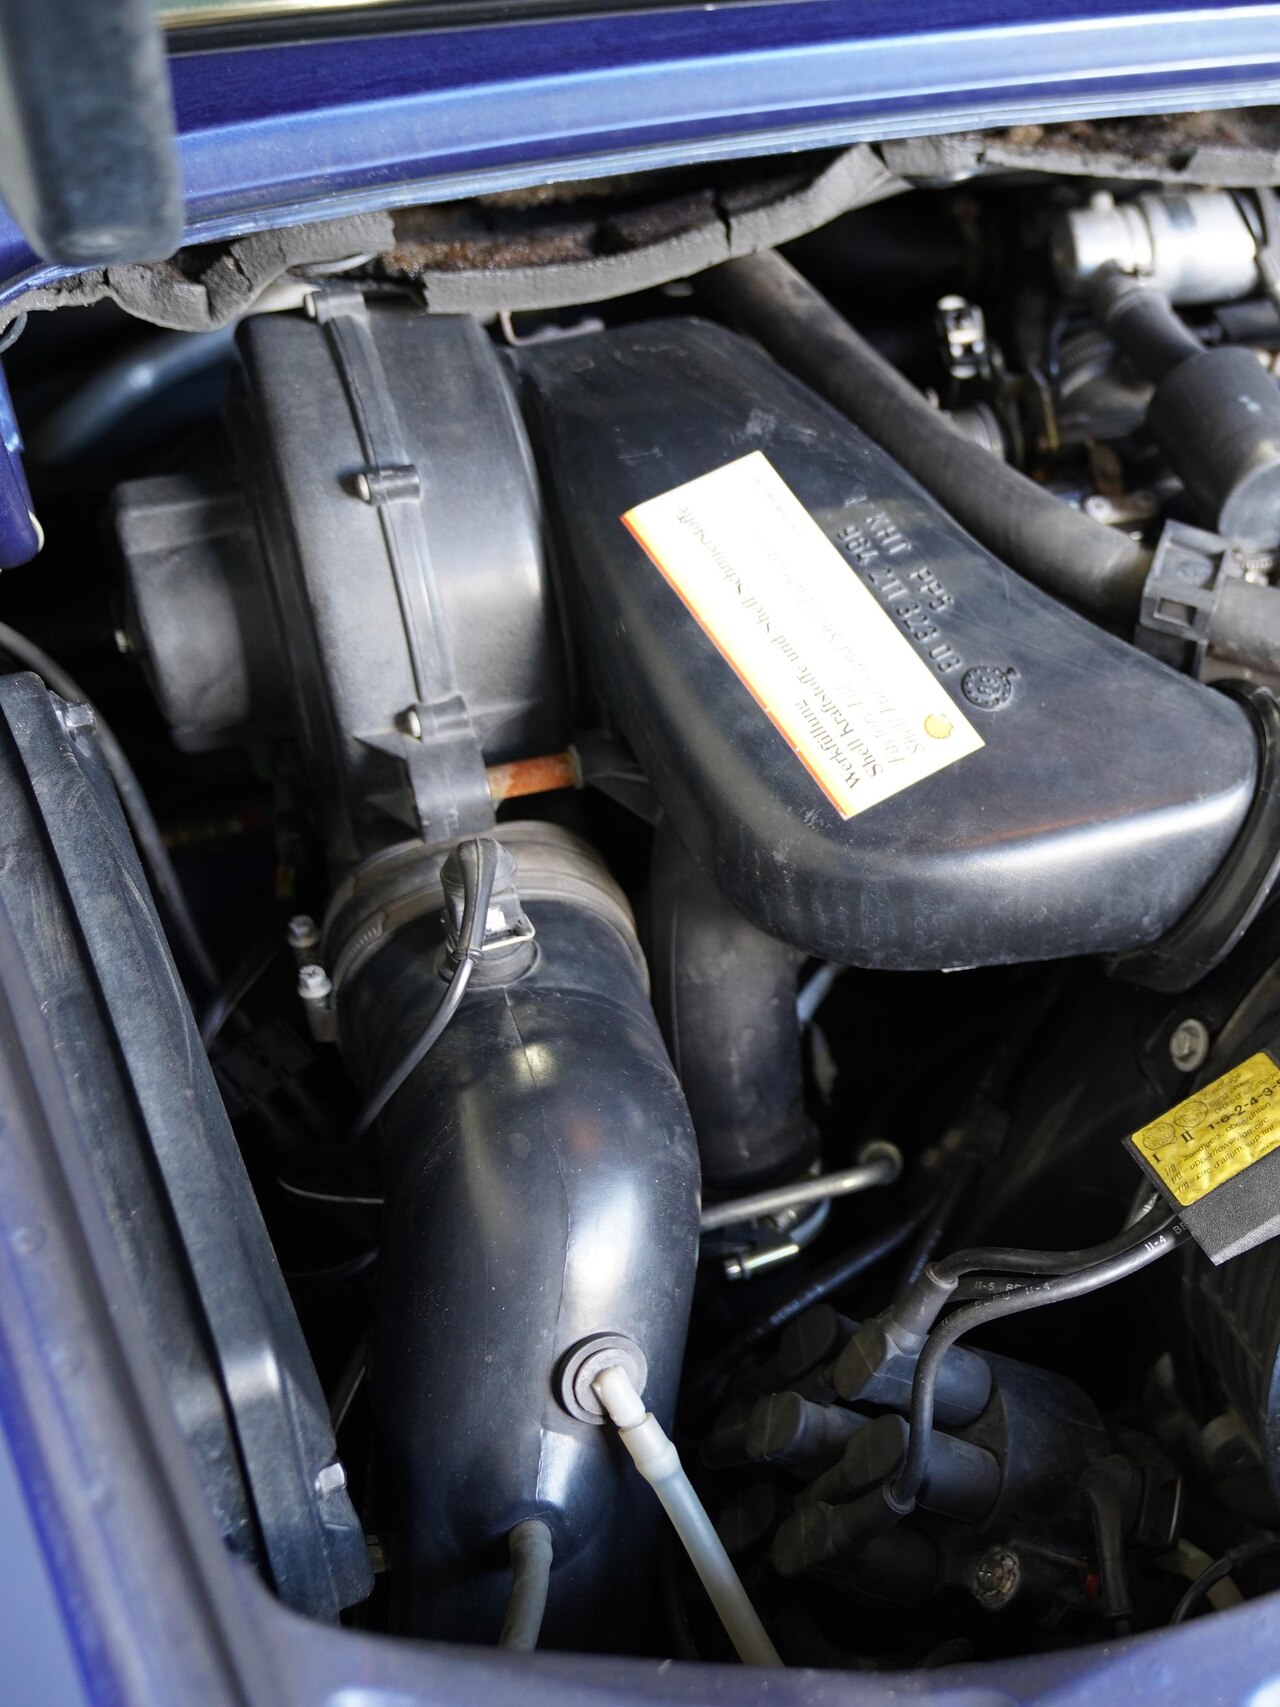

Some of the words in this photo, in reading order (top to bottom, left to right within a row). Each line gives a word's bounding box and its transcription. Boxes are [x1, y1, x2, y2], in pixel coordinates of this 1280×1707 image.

[671, 504, 749, 596] Schmierstoffe
[741, 596, 777, 634] Shell
[835, 522, 881, 568] 964
[867, 562, 909, 604] 211
[894, 596, 942, 648] 323
[927, 639, 964, 678] 03
[769, 634, 799, 663] und
[791, 664, 855, 737] Kraftstoffe
[789, 698, 866, 788] Werkfüllung
[846, 737, 885, 778] Shell
[1179, 1130, 1194, 1143] II
